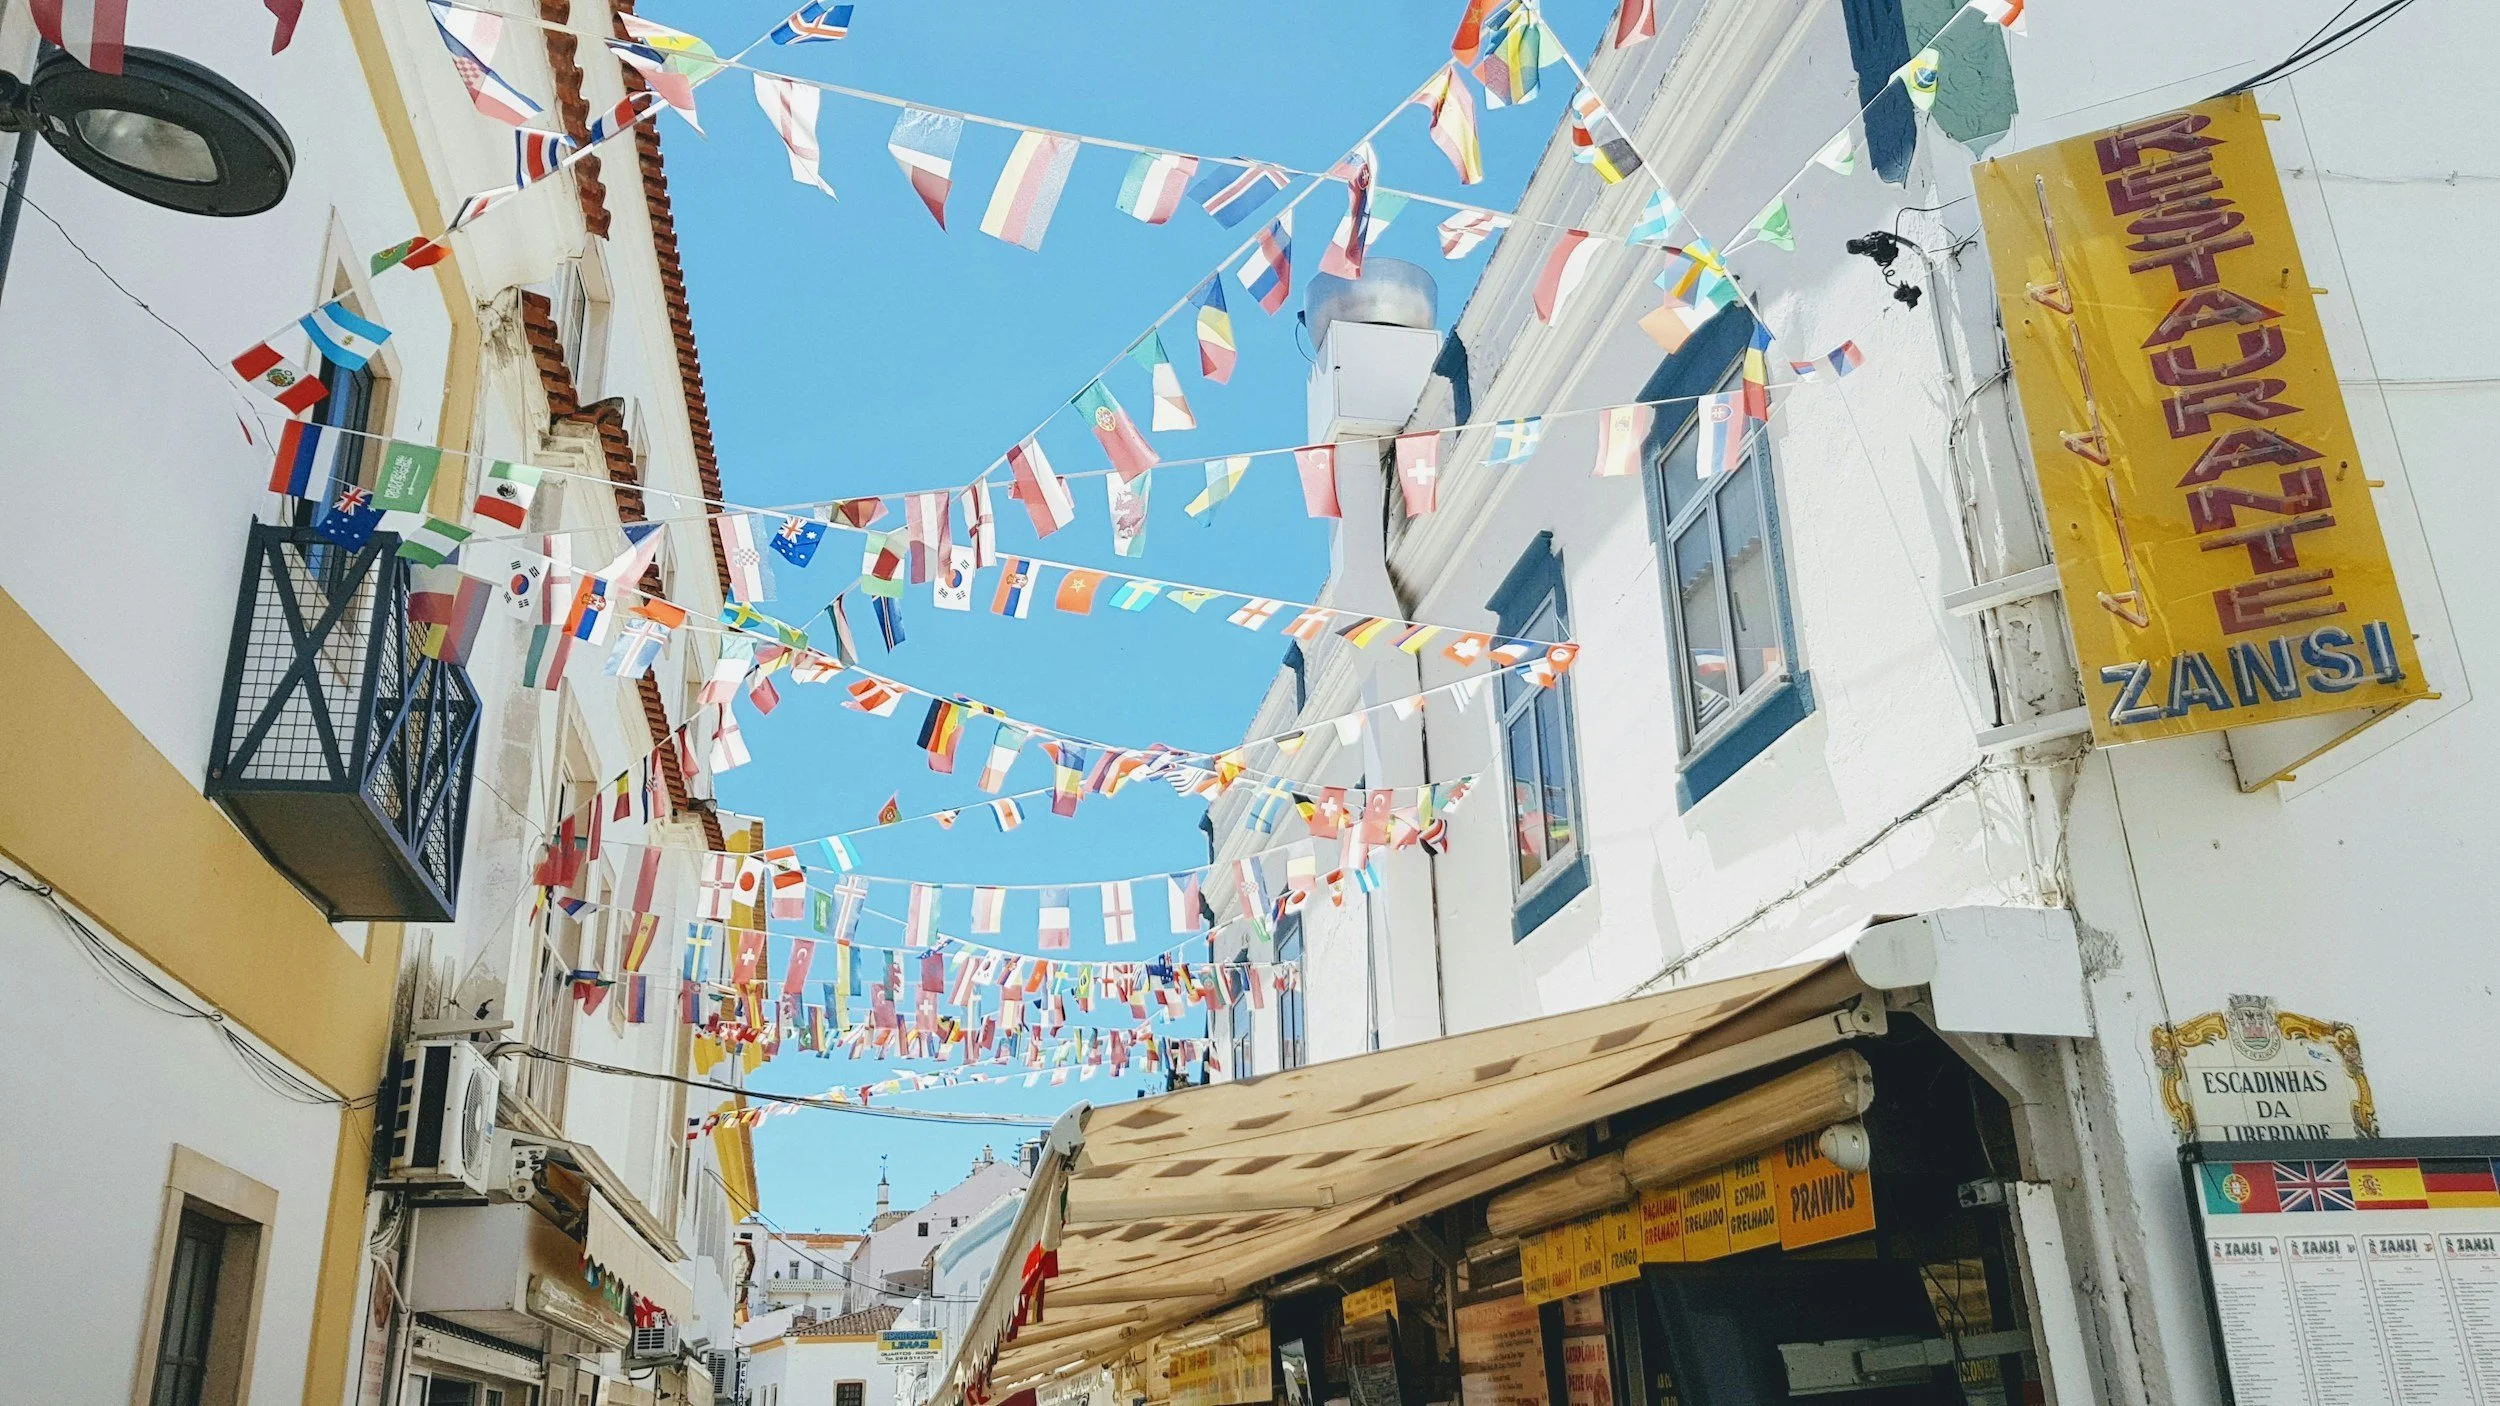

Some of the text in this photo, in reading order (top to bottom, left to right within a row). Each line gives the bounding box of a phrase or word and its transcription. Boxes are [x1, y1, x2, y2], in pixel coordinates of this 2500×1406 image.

[2094, 110, 2347, 635] RESTAURANTE
[2099, 619, 2402, 726] ZANSI
[2202, 1070, 2328, 1094] ESCADINHAS
[2256, 1100, 2291, 1118] DA
[1734, 1155, 1760, 1181] PEIXE
[1682, 1182, 1721, 1210] LINGUADO
[1734, 1181, 1766, 1207] ESPADA
[1790, 1171, 1856, 1224] PRAWNS
[1642, 1195, 1678, 1222] BACALHAU
[1684, 1207, 1724, 1235] GRELHADO
[1730, 1205, 1775, 1235] GRELHADO
[1617, 1223, 1627, 1242] DE
[1644, 1219, 1680, 1247] GRELHADO
[2456, 1237, 2496, 1253] ZANSI
[1611, 1247, 1638, 1270] FRANGO
[2224, 1241, 2263, 1257] ZANSI
[2302, 1239, 2340, 1256] ZANSI
[2379, 1238, 2418, 1254] ZANSI
